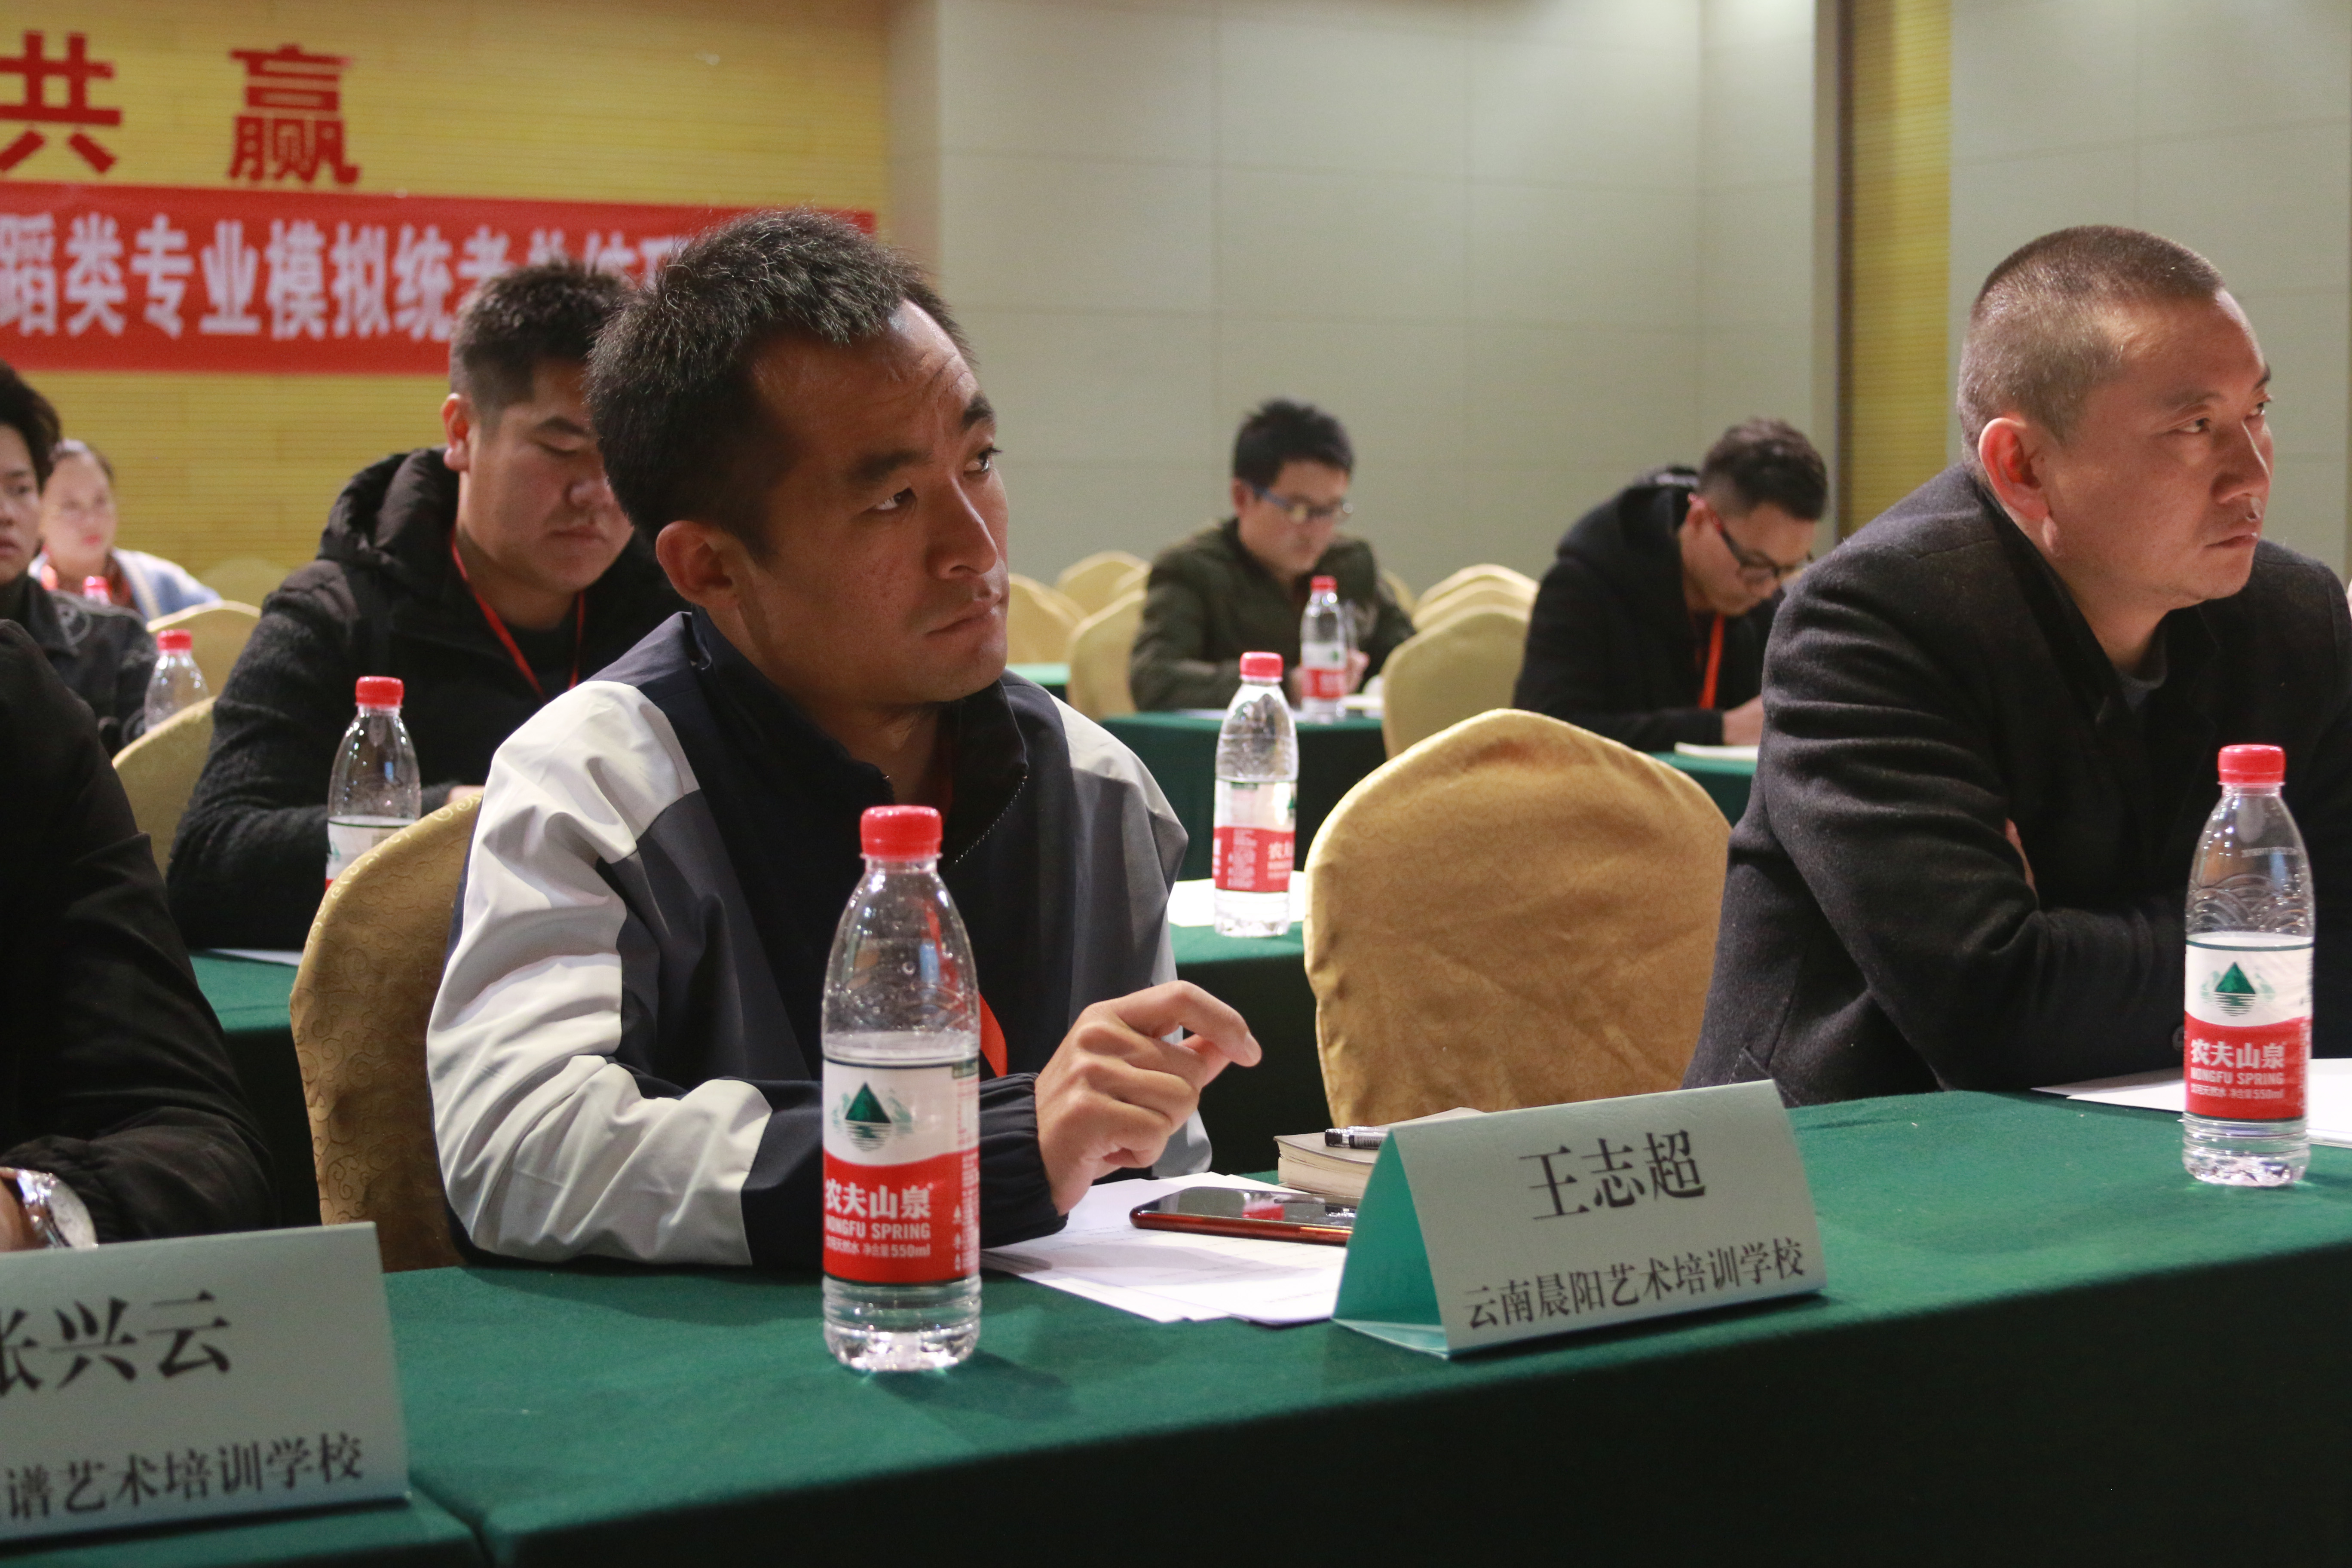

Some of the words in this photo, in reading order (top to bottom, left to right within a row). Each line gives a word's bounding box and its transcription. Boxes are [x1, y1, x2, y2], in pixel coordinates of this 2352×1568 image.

[0, 211, 690, 340] 蹈类专业模拟统
[2191, 1038, 2285, 1069] 农夫山泉
[2236, 1072, 2285, 1085] SPRING
[825, 1178, 931, 1219] 农夫山泉
[1519, 1130, 1706, 1221] 王志超
[871, 1222, 931, 1240] SPRING
[1463, 1238, 1804, 1329] 云南晨阳艺术培训学校
[6, 1432, 362, 1519] 谱艺术培训学校
